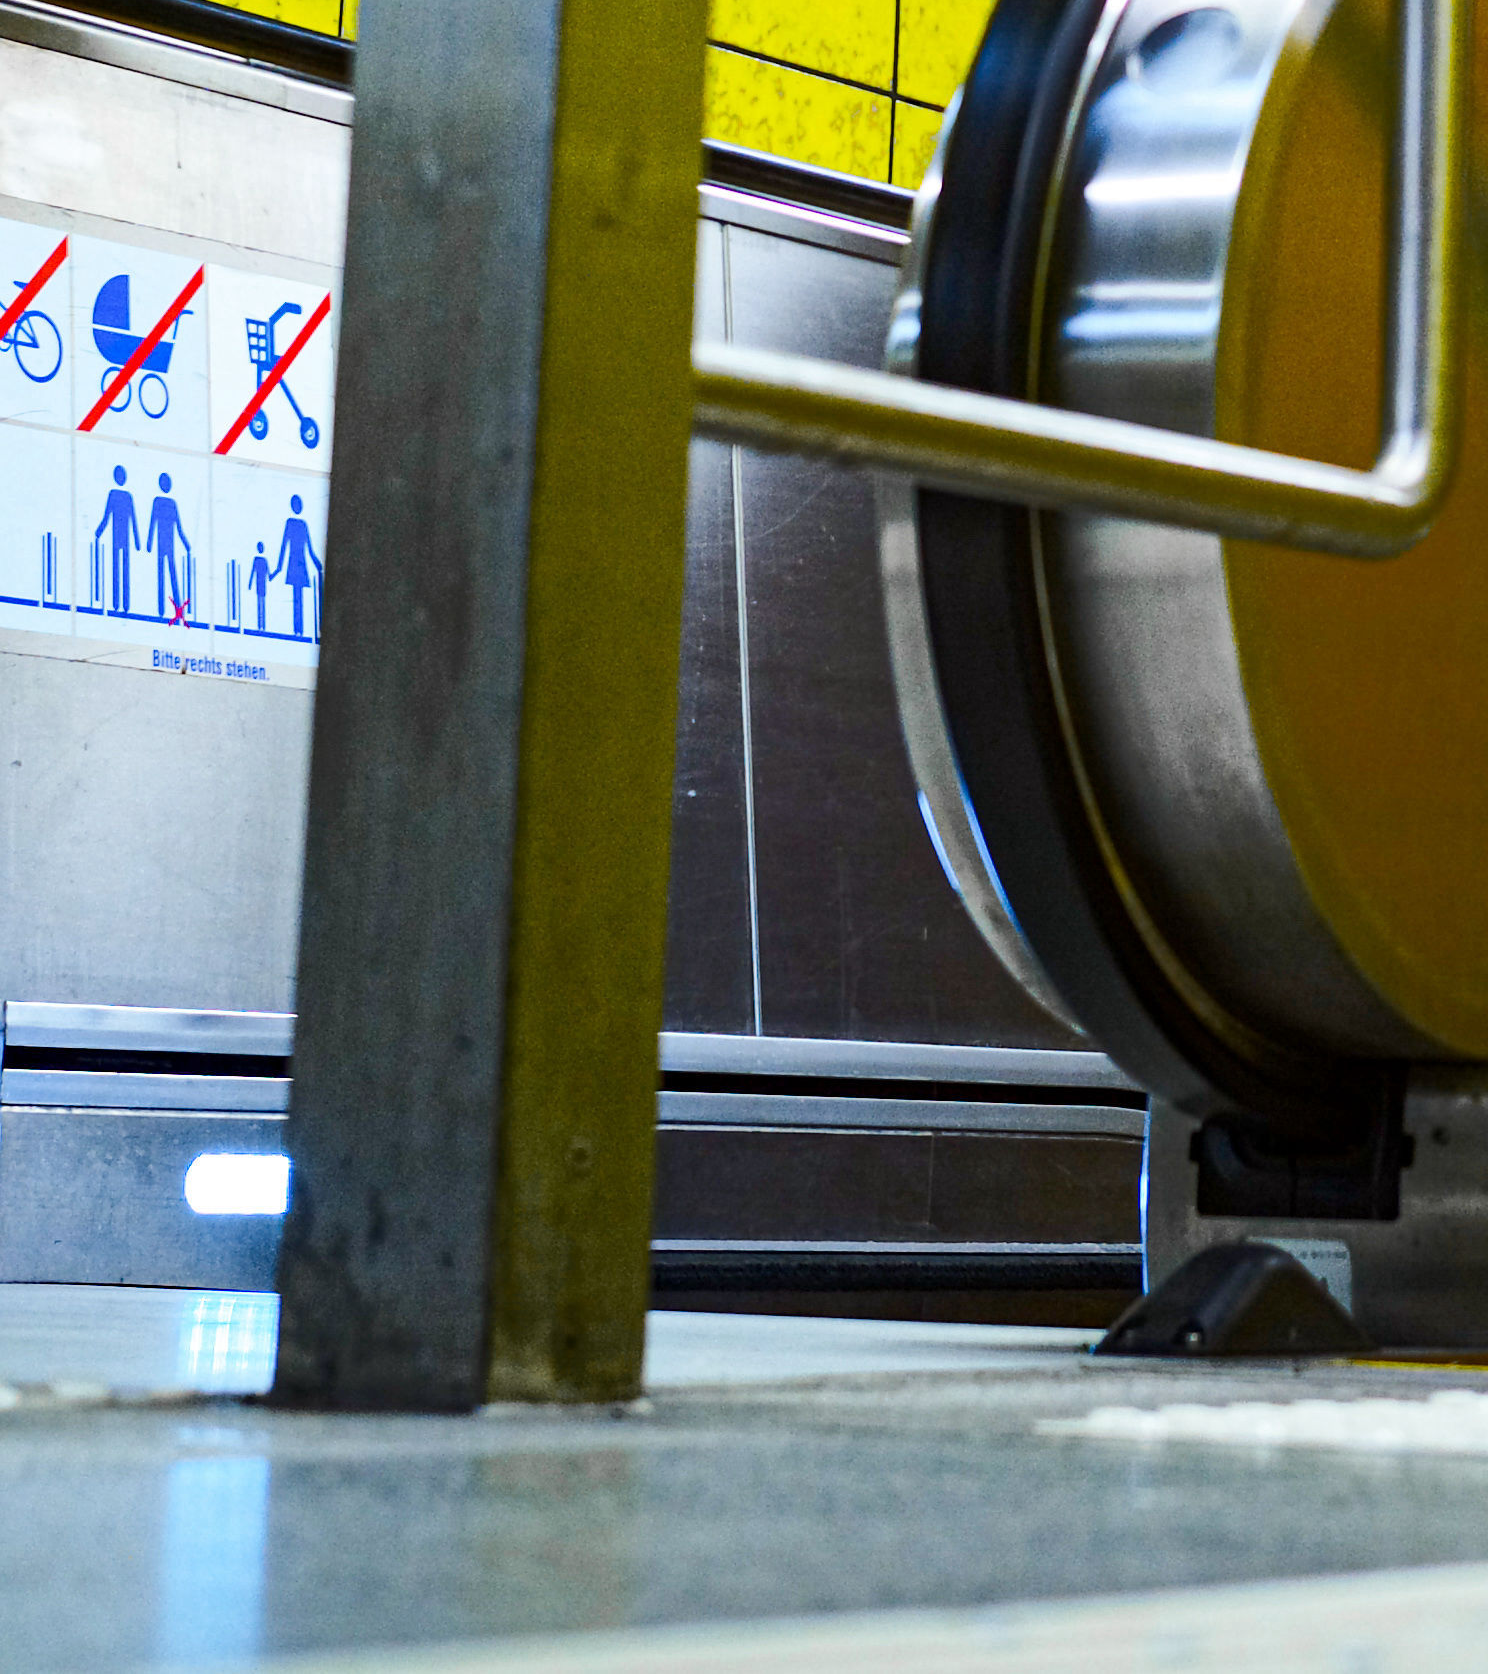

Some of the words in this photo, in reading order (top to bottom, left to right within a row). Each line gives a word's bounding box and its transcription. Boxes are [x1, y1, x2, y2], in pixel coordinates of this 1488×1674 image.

[153, 649, 181, 669] Bitte
[185, 657, 222, 675] rechts
[226, 661, 270, 680] stehen.
